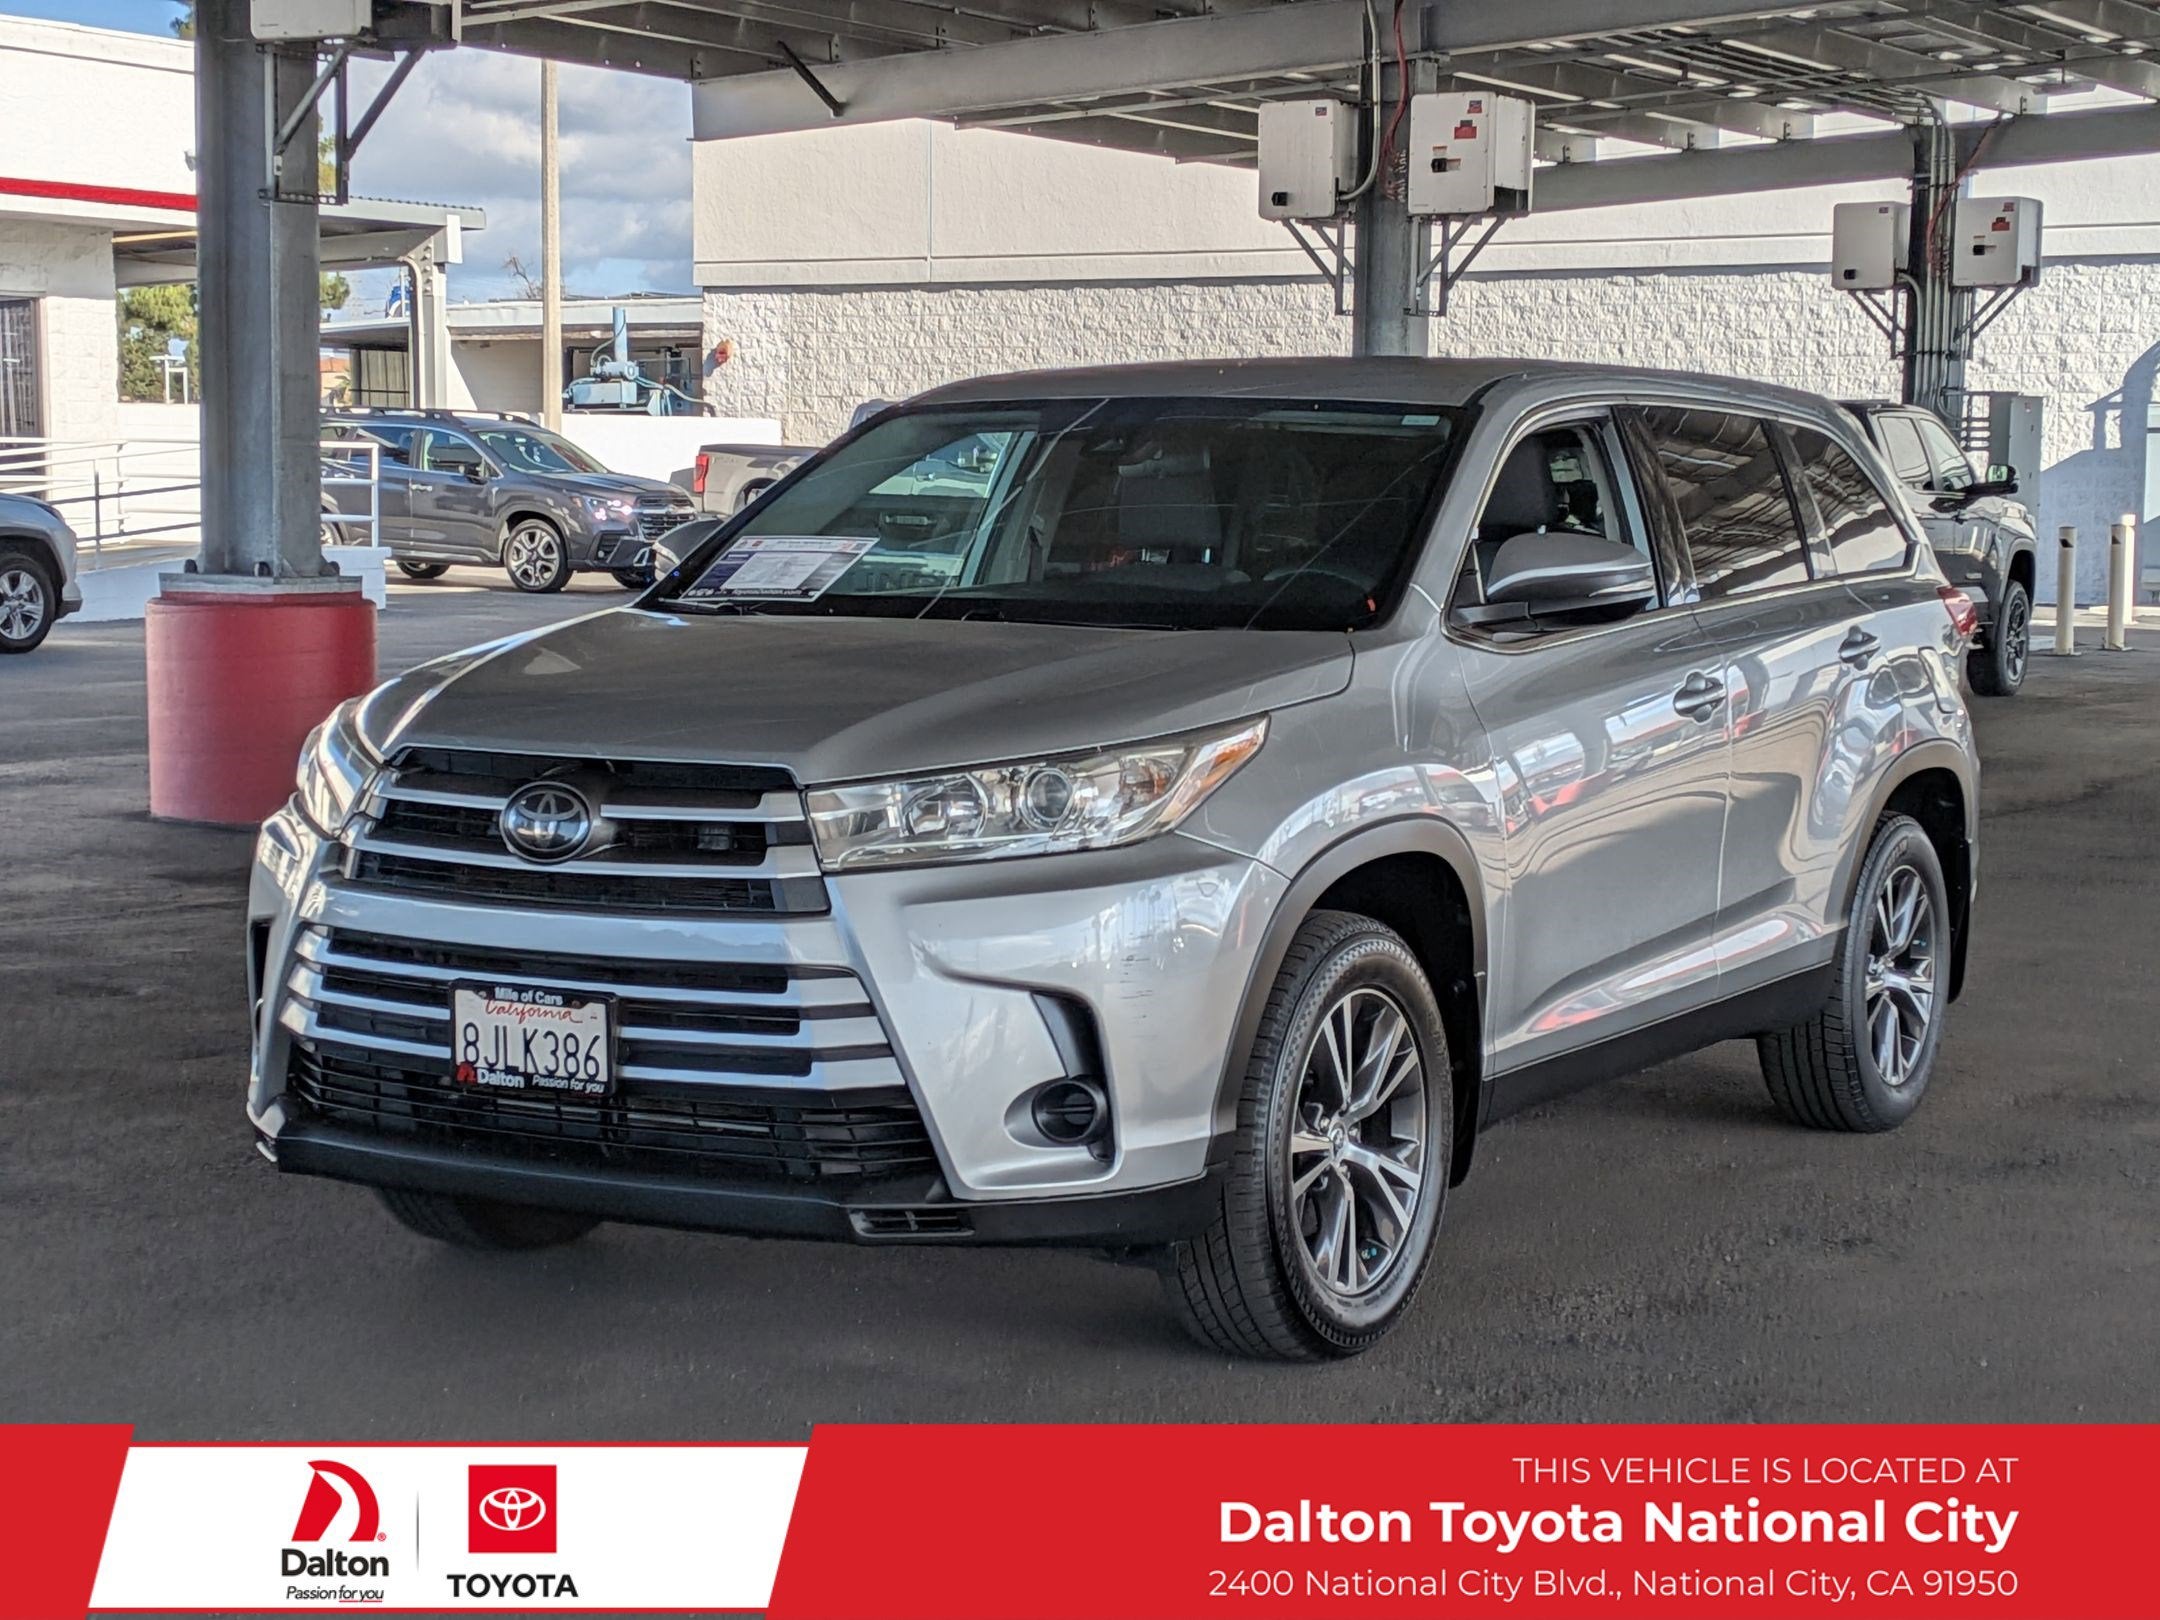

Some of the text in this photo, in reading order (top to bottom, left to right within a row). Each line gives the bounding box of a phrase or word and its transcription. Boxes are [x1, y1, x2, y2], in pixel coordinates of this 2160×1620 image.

[494, 986, 563, 1006] Mile of Cars
[485, 999, 583, 1024] California
[463, 1022, 601, 1082] 8JLK386
[477, 1068, 525, 1089] Dalton
[531, 1074, 605, 1094] Passion for you
